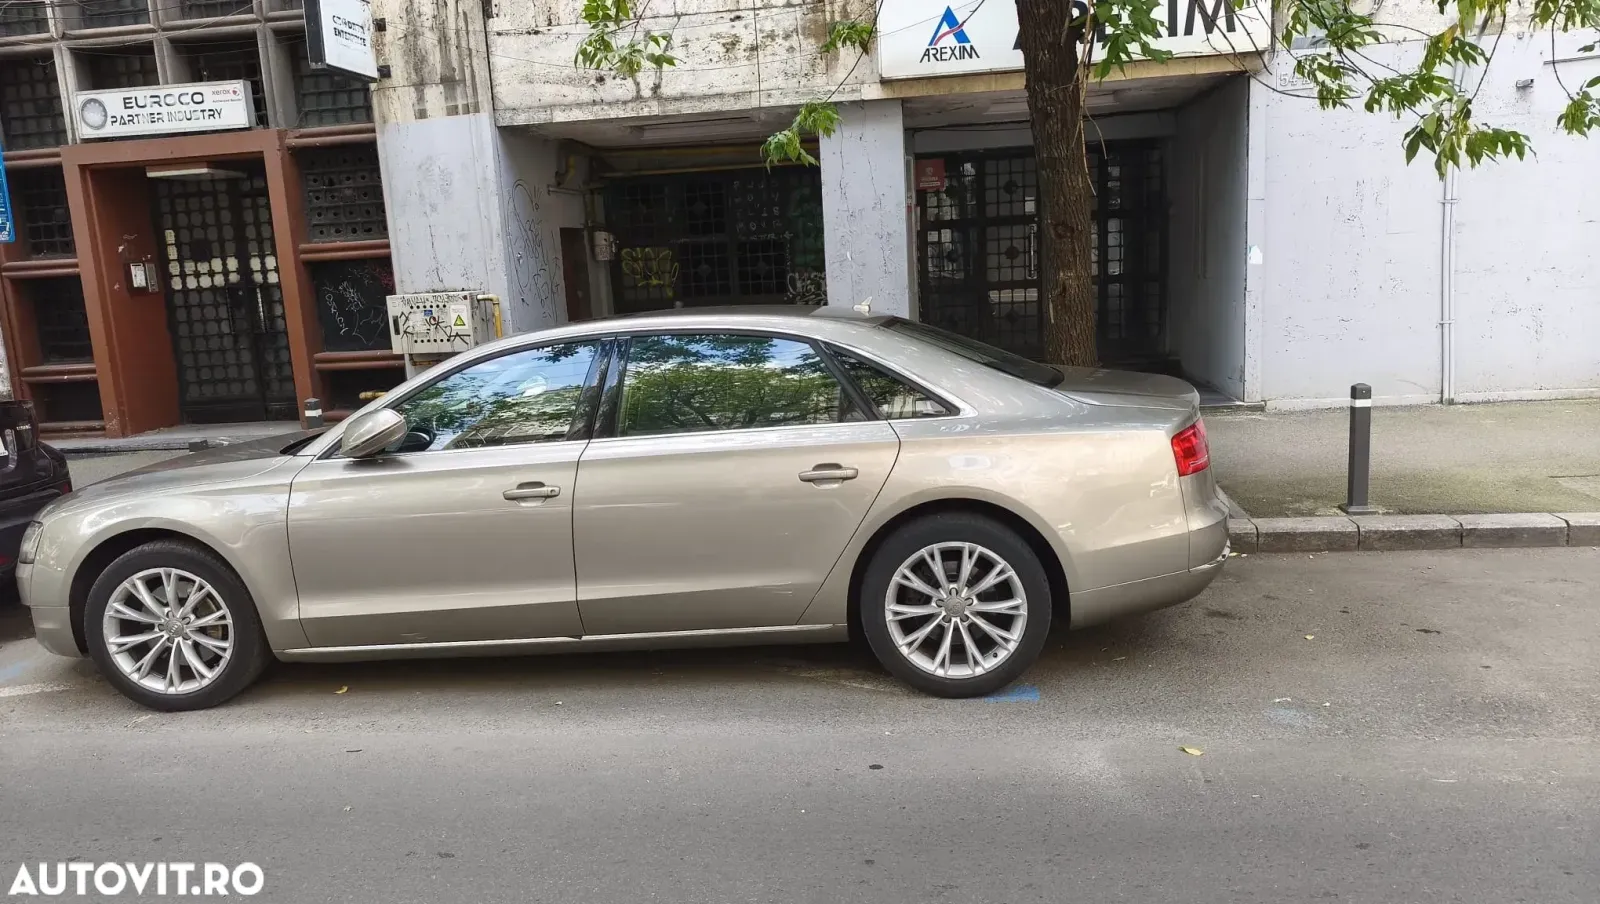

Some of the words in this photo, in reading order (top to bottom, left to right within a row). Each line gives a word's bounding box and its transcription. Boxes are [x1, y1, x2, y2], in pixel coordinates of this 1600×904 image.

[919, 45, 981, 63] AREXIM
[122, 91, 205, 110] EUROCO
[211, 88, 231, 96] xerox
[110, 112, 165, 126] PARTNER
[166, 107, 223, 122] INDUSTRY
